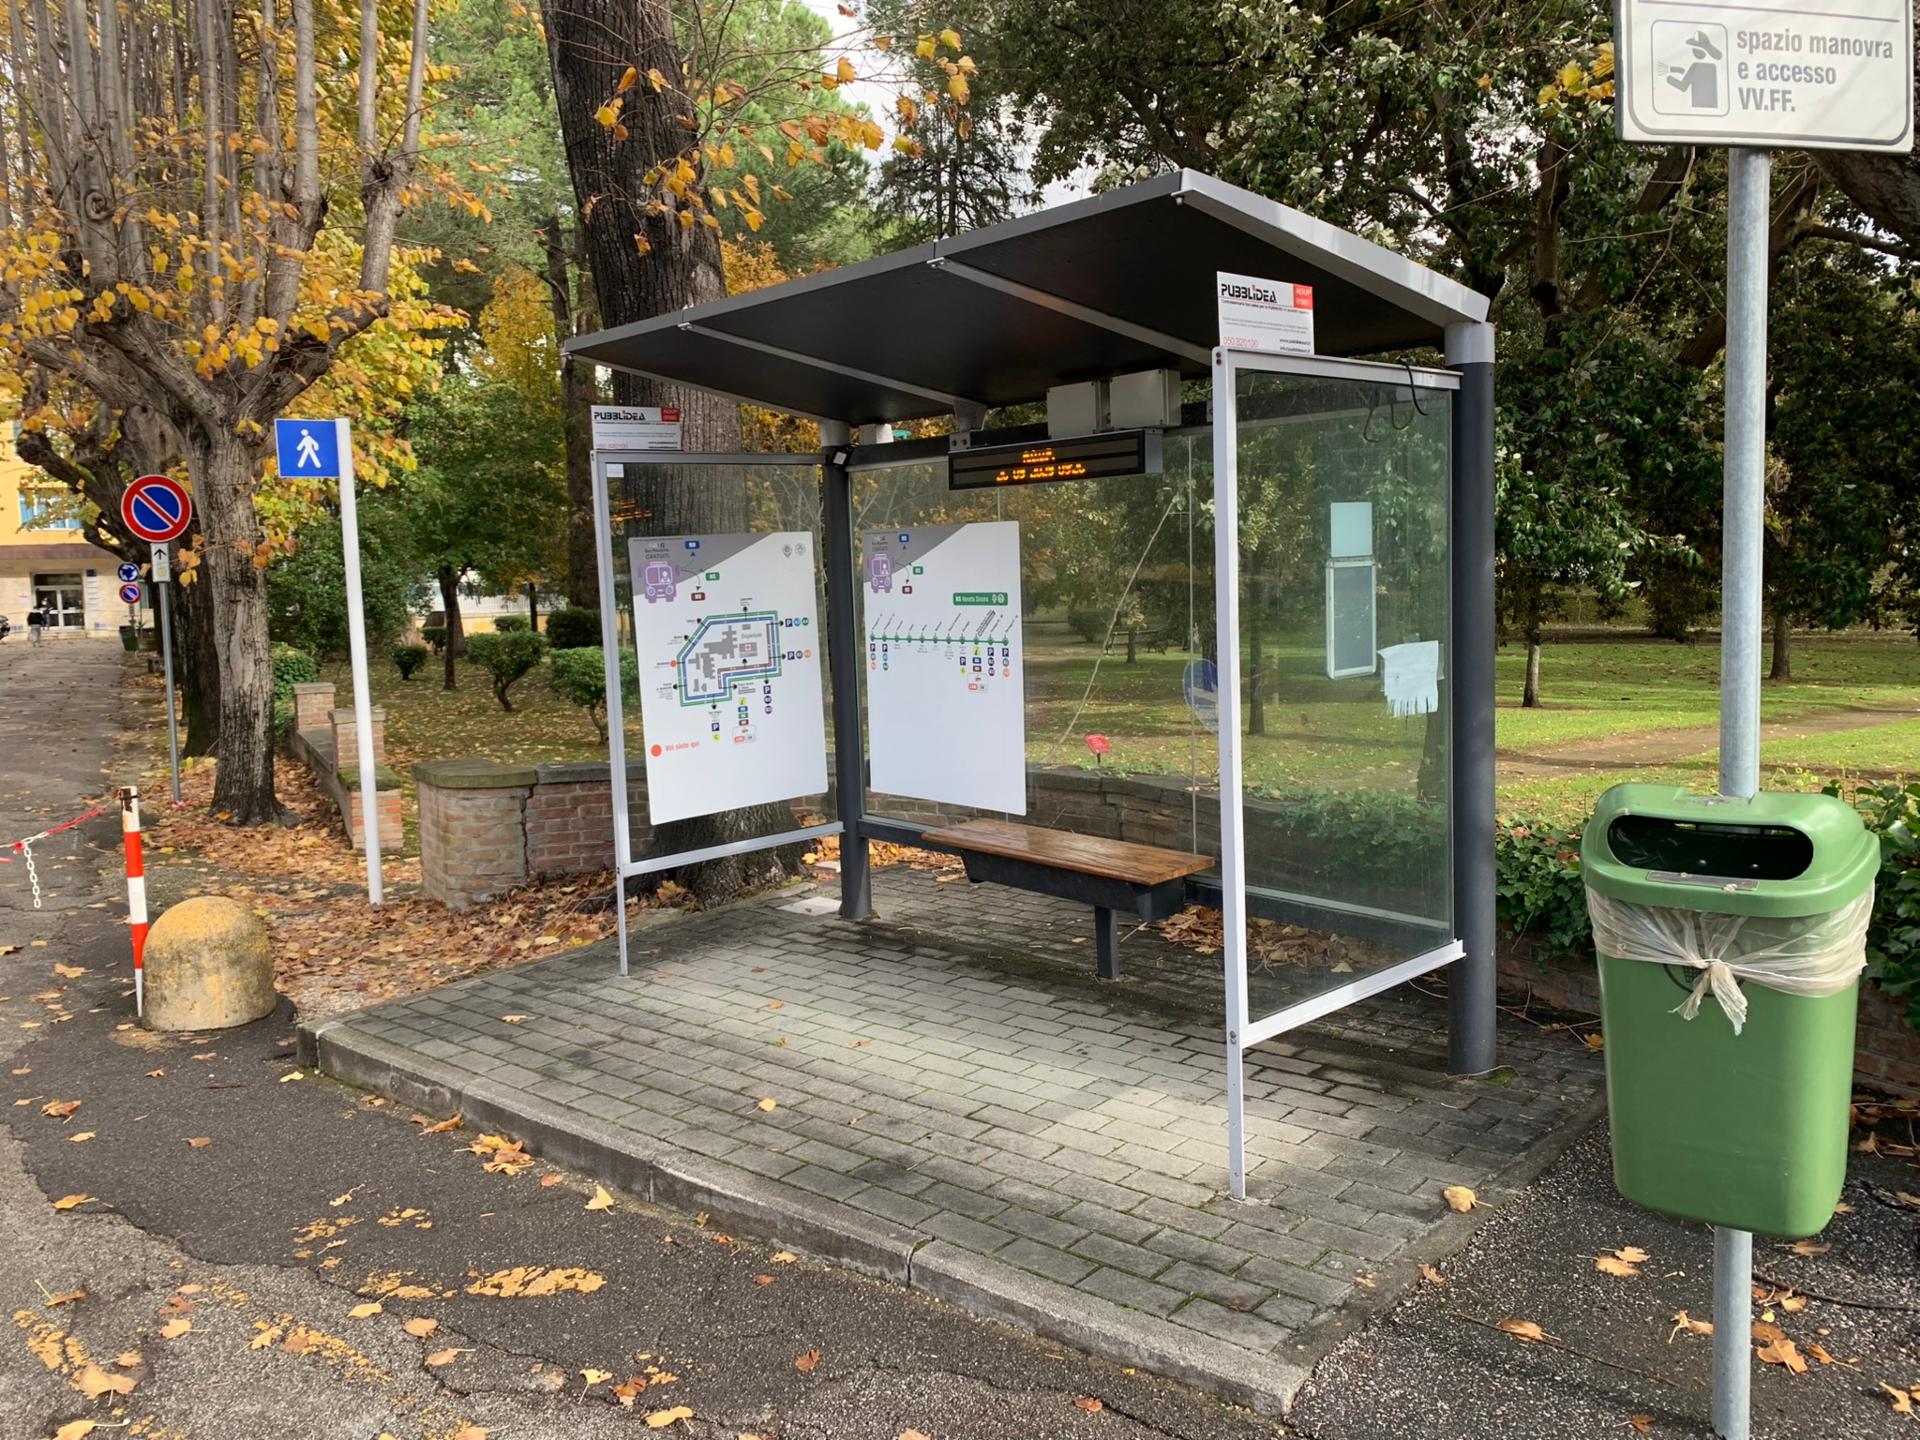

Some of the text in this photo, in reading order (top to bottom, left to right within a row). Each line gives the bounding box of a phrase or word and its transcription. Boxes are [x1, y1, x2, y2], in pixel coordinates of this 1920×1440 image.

[1737, 28, 1894, 59] spazio manovra
[1737, 62, 1837, 85] e accesso
[1738, 87, 1796, 112] VV.FF.
